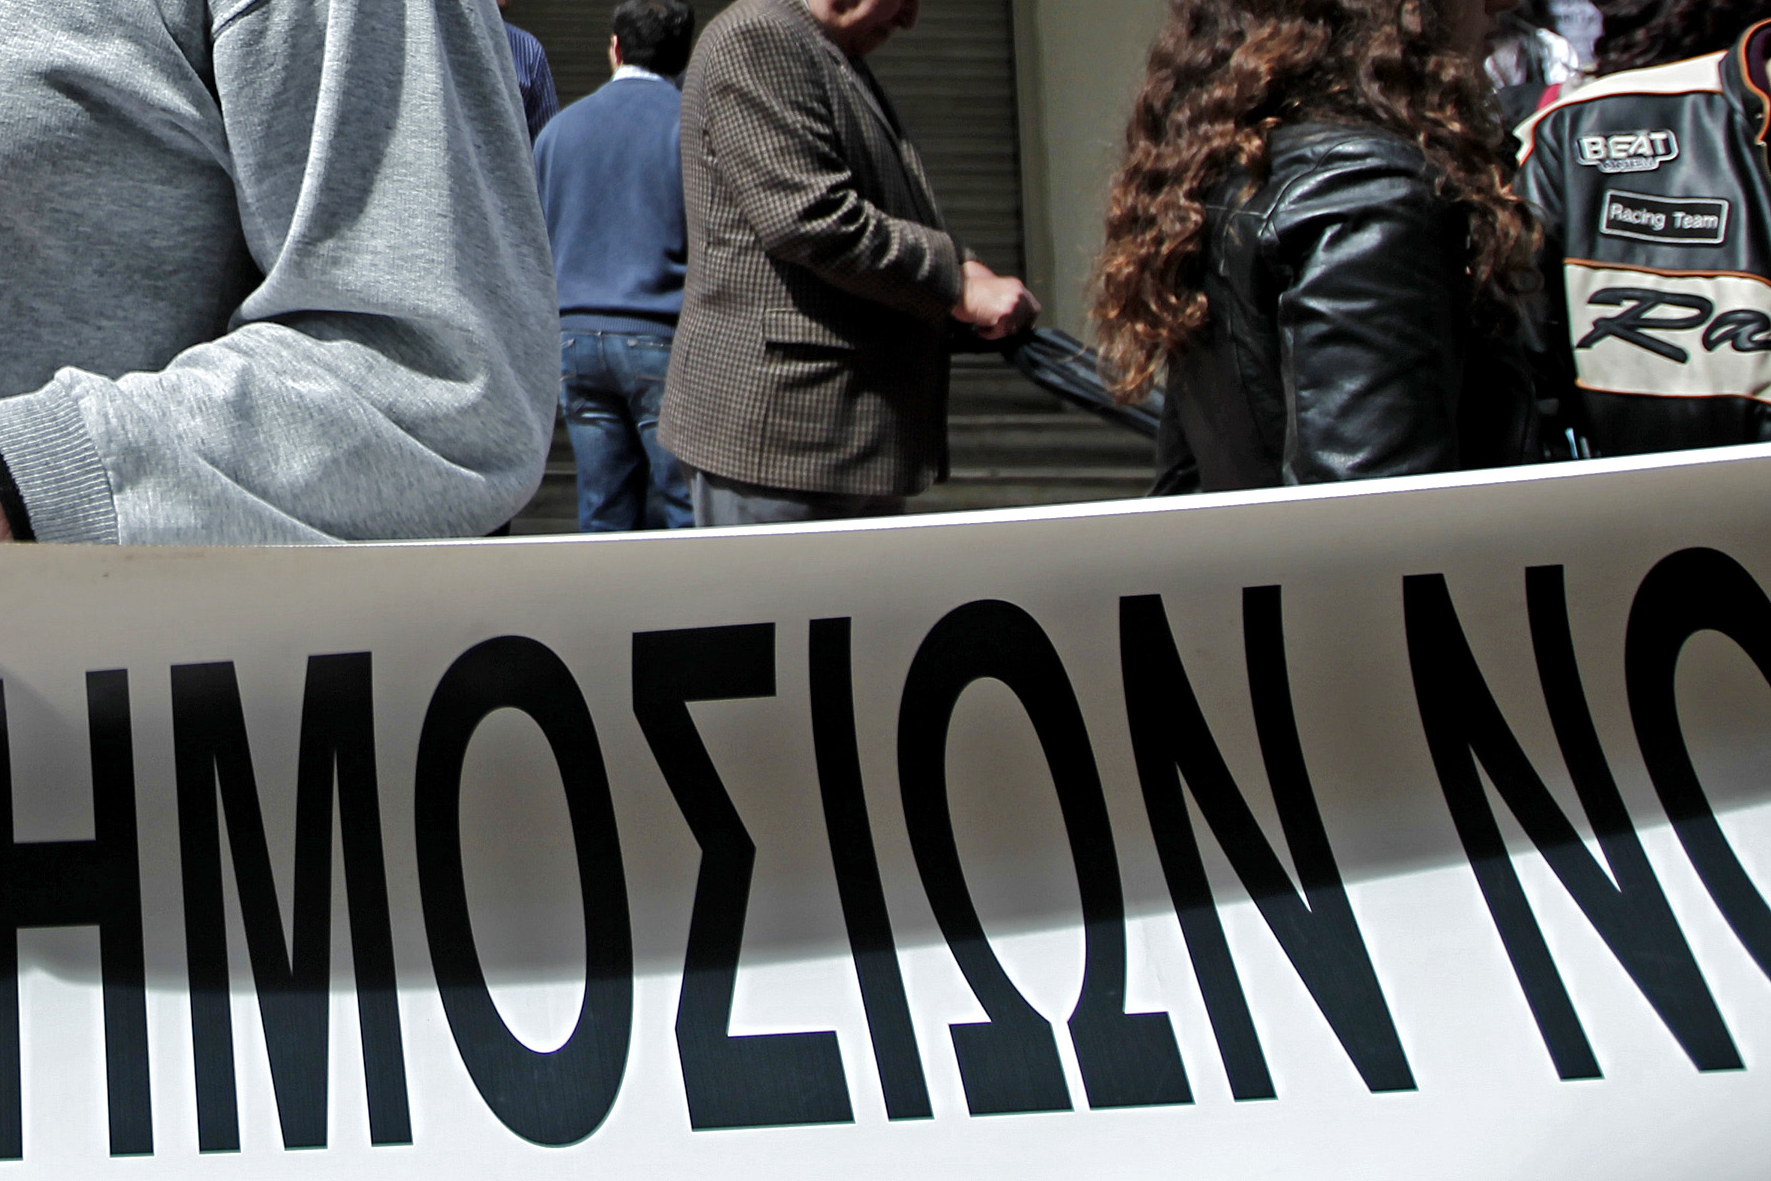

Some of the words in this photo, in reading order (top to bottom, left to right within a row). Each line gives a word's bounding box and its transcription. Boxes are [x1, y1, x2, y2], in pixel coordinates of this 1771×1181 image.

[1580, 131, 1669, 161] BEAT
[1609, 202, 1666, 231] Racing
[1672, 210, 1719, 230] Team
